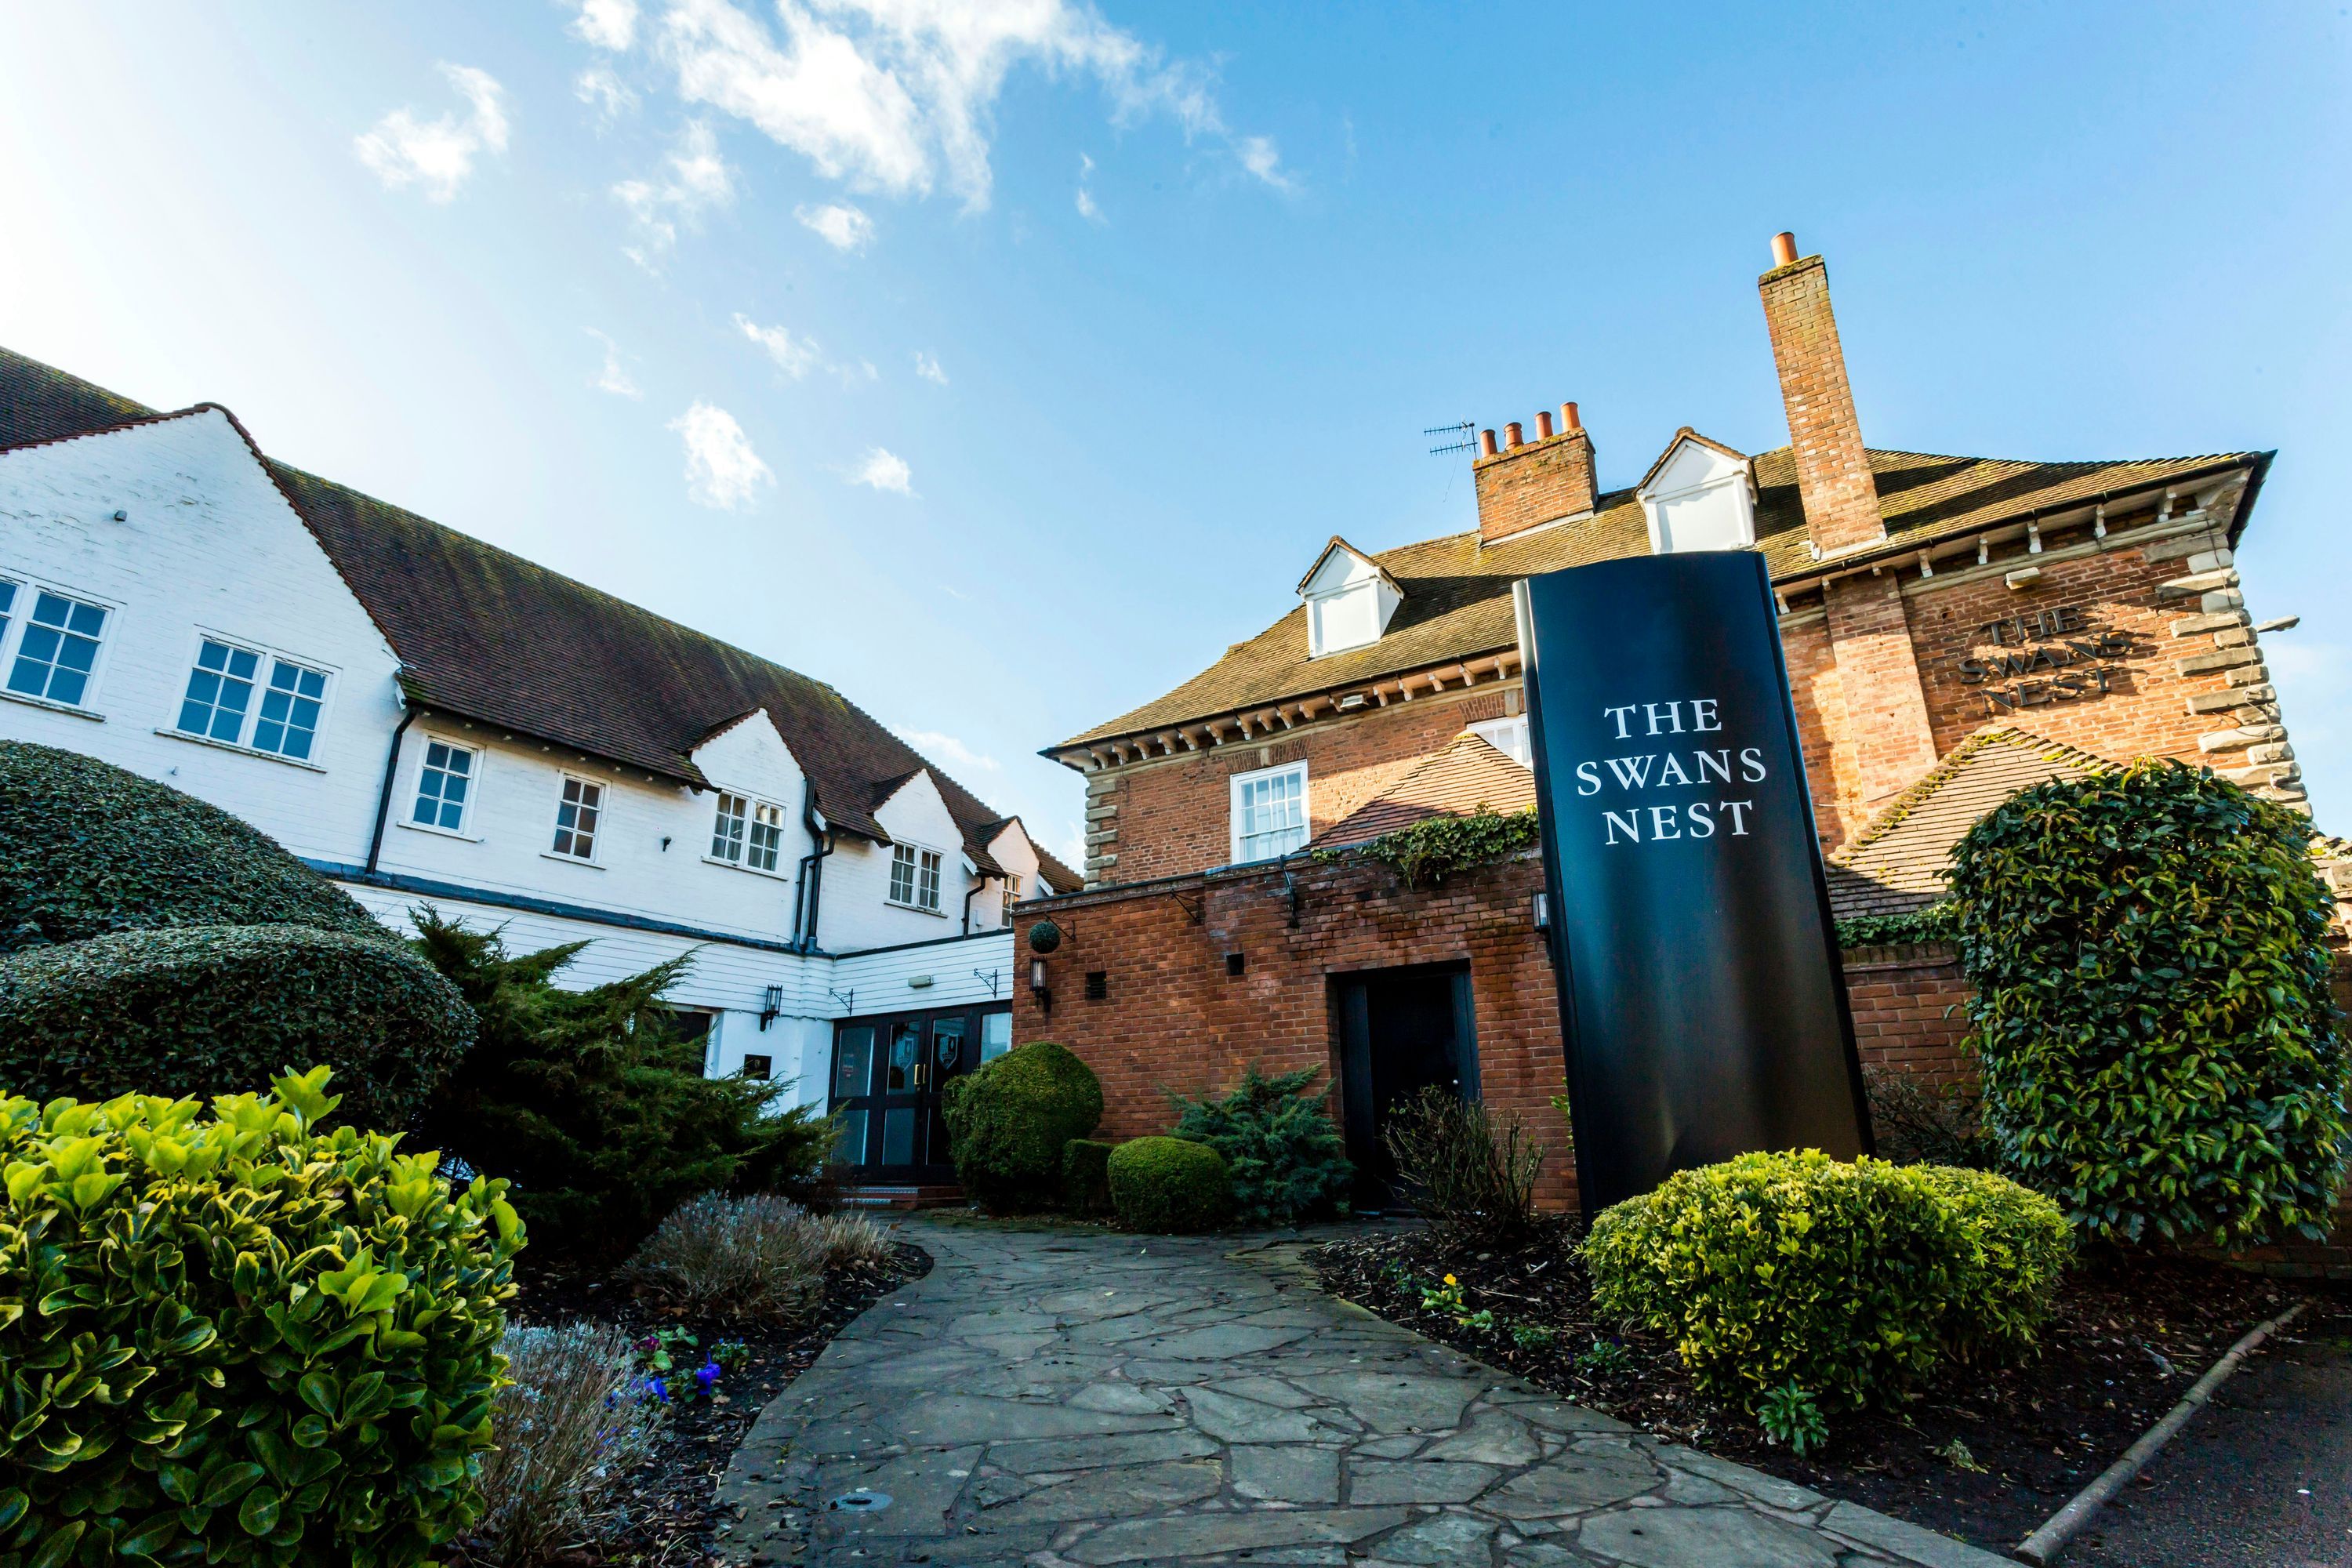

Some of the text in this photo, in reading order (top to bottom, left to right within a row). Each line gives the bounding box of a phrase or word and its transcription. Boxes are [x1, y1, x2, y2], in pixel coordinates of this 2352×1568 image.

[1981, 608, 2085, 645] THE
[1960, 630, 2131, 684] SWANS
[1979, 665, 2117, 713] NEST
[1604, 699, 1722, 739] THE
[1577, 748, 1766, 796] SWANS
[1602, 800, 1753, 845] NEST
